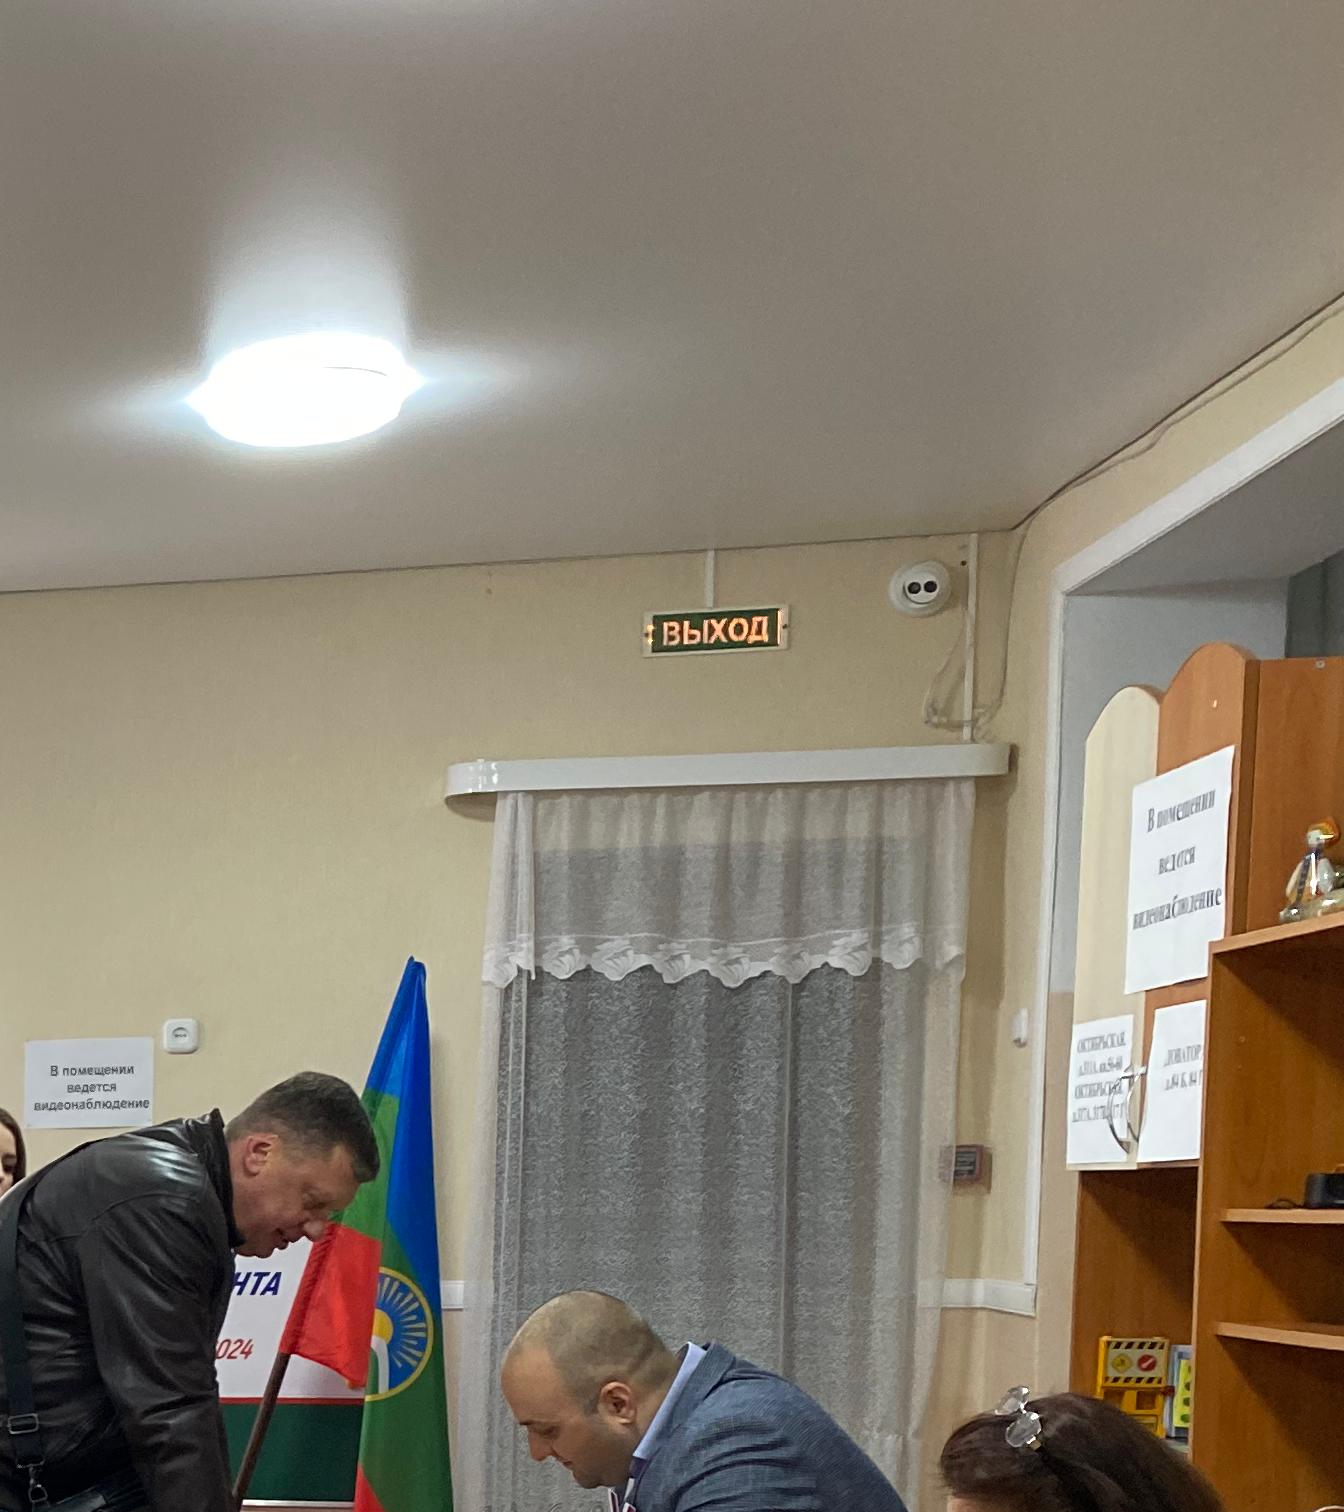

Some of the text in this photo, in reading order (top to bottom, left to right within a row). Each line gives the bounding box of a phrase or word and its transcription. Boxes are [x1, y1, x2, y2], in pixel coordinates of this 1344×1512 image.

[663, 616, 769, 646] ВЫХОД
[1147, 789, 1216, 833] В помещении
[50, 1065, 135, 1076] В помещении
[67, 1083, 117, 1094] ведется
[33, 1098, 150, 1111] видеонаблюдение
[232, 1272, 282, 1296] НТА
[216, 1338, 254, 1359] 024
